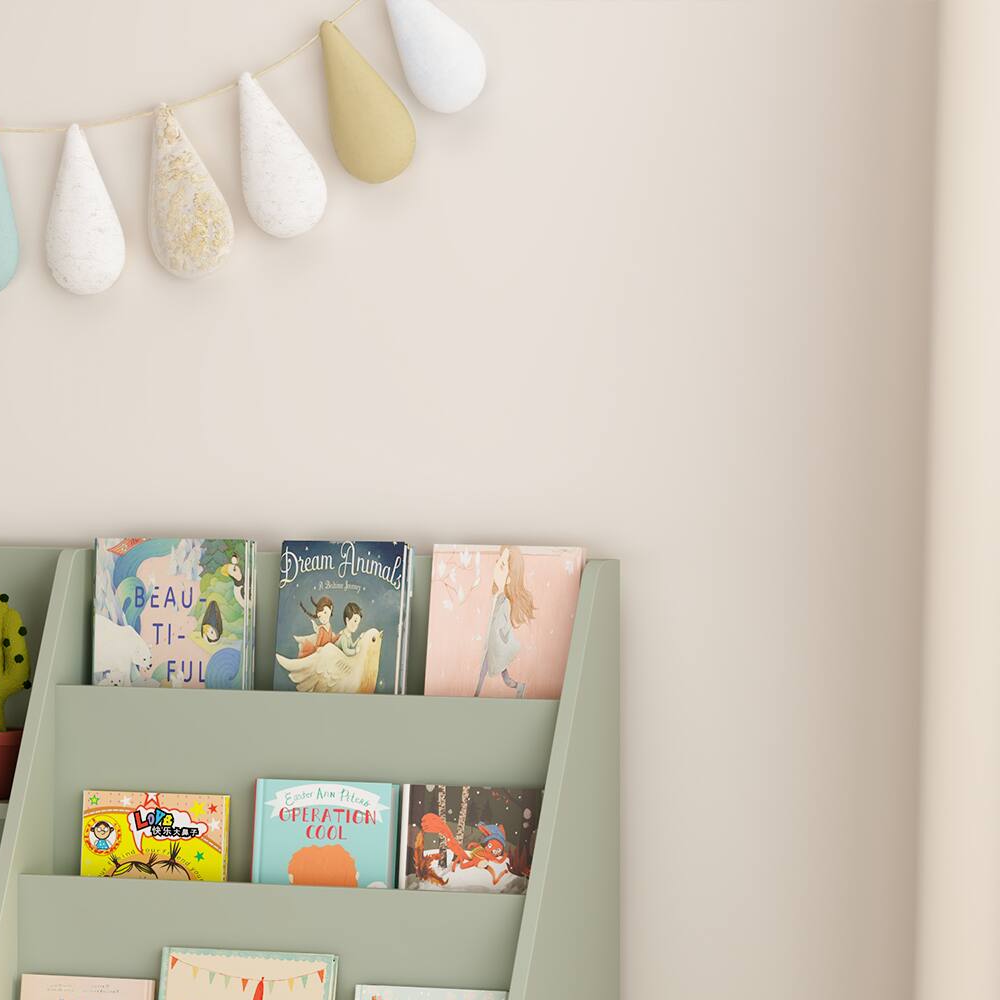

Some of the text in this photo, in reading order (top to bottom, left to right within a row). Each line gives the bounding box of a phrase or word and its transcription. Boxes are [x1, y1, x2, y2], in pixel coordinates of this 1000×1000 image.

[280, 541, 401, 590] Dream Animals
[135, 586, 207, 608] BEAU-
[152, 623, 185, 645] TI-
[167, 660, 206, 683] FUL
[279, 806, 376, 824] OPERATION
[306, 825, 348, 840] COOL
